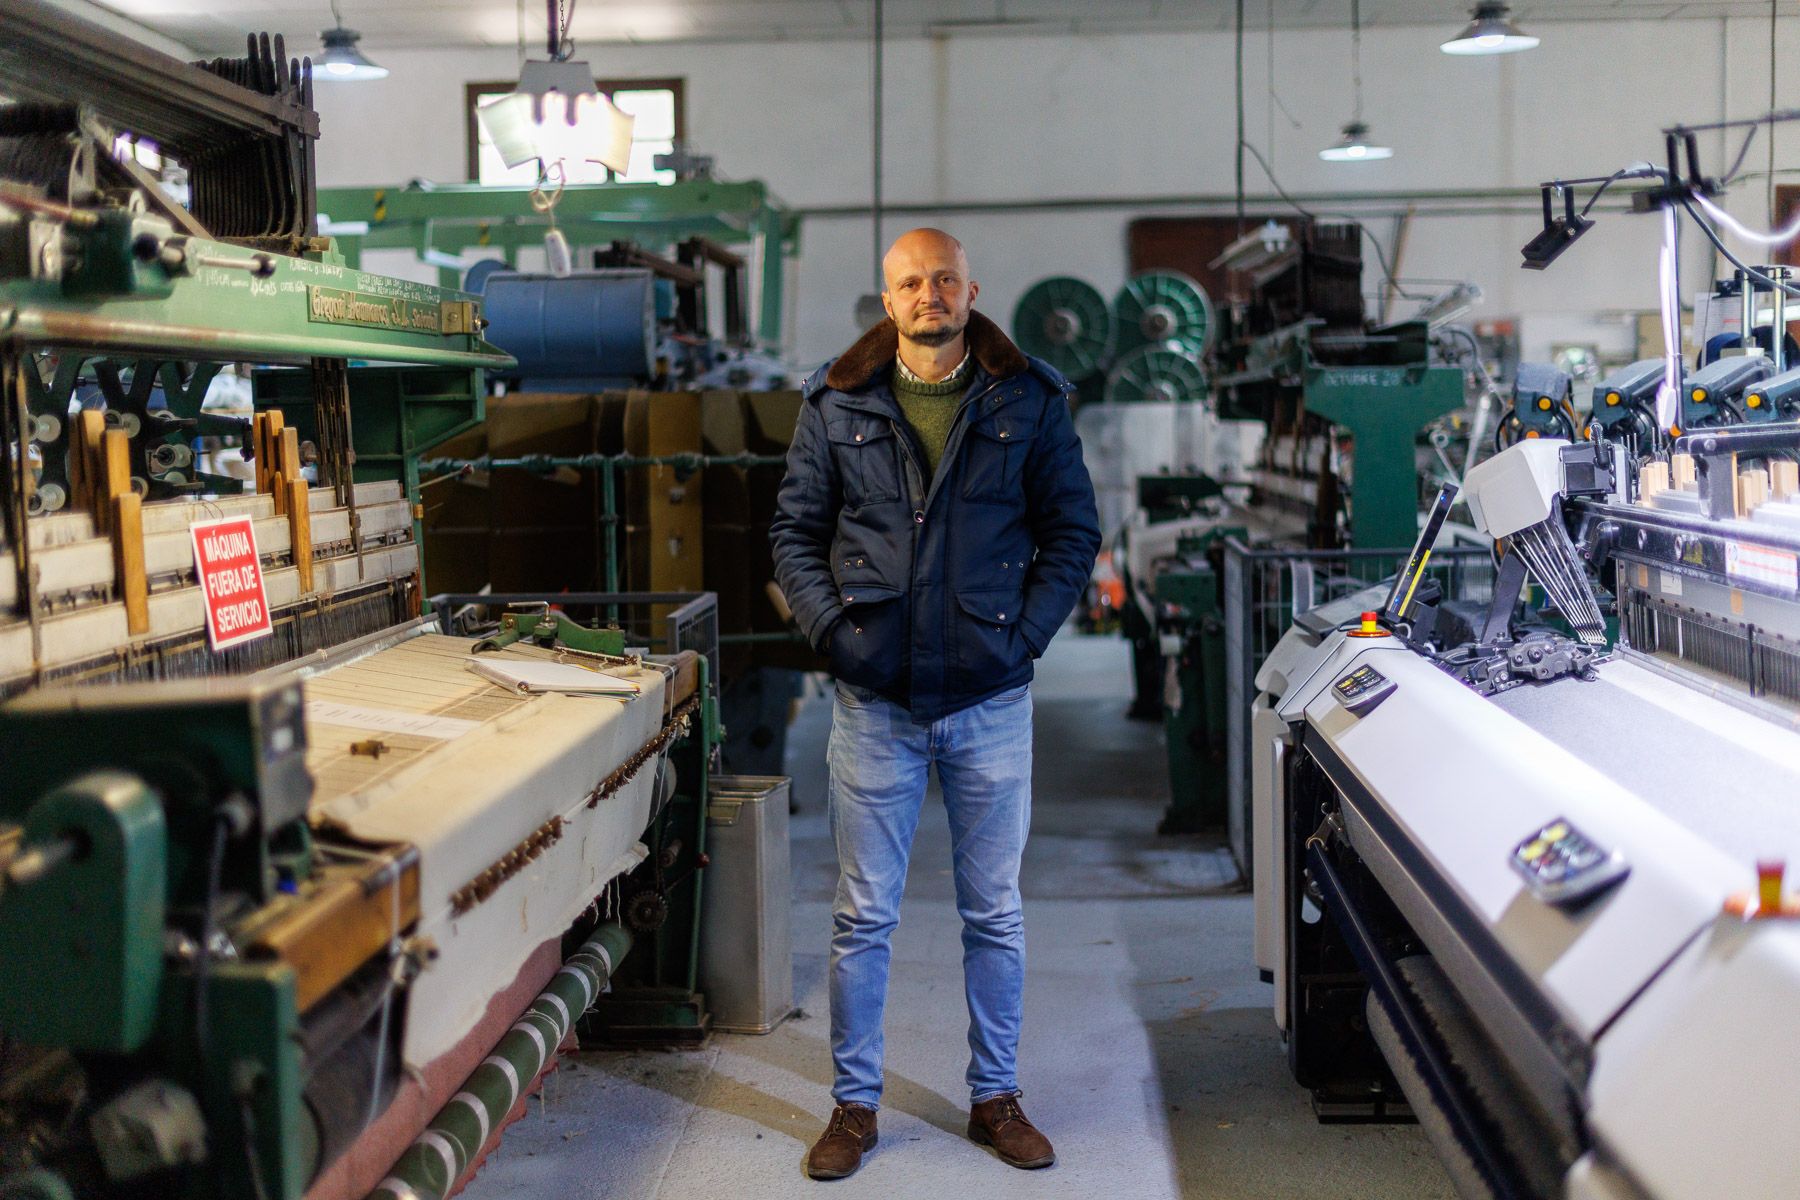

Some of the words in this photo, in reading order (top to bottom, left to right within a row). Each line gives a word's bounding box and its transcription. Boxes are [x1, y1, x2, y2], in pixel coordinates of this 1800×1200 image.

[204, 530, 252, 562] MÁQUINA
[208, 571, 243, 598] FUERA
[243, 564, 258, 590] DE
[217, 599, 262, 633] SERVICIO
